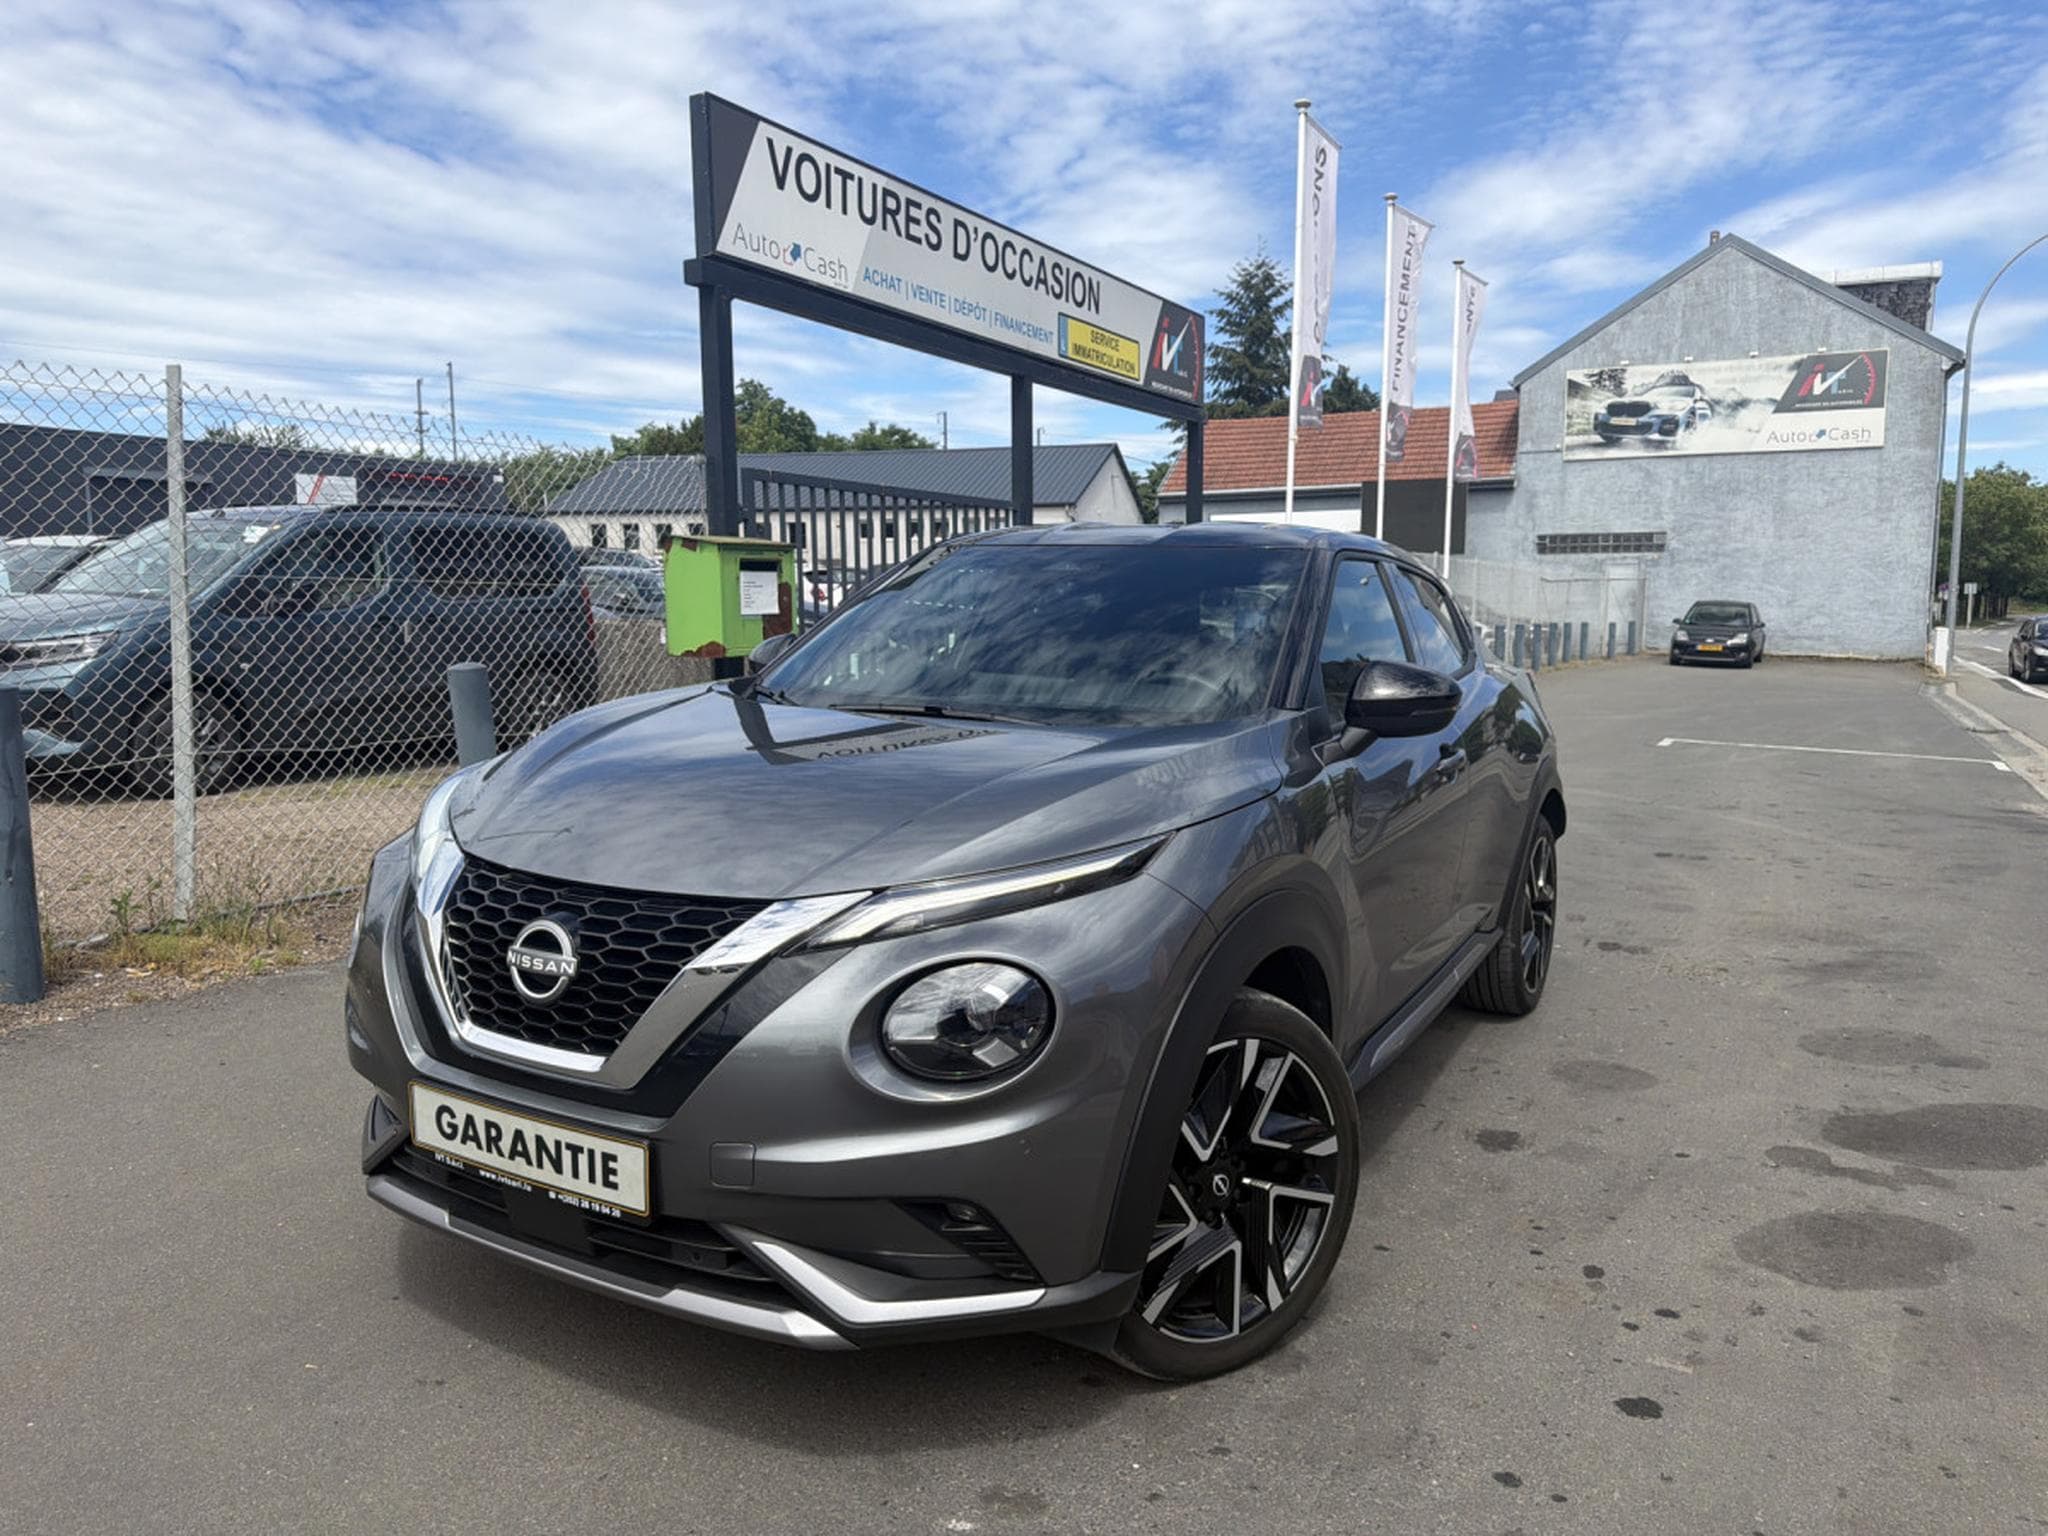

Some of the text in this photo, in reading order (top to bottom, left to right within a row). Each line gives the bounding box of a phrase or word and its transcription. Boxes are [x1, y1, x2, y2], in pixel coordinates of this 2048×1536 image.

[733, 222, 849, 282] Auto Cash
[765, 136, 1101, 315] VOITURES D'OCCASION
[863, 267, 1054, 343] ACHAT VENTE DÉPÔT FINANCEMENT
[1392, 229, 1417, 392] FINANCEMENT
[1072, 342, 1137, 375] IMMATRICULATION
[1090, 329, 1120, 352] SERVICE
[1767, 427, 1872, 444] Auto Cash
[507, 949, 575, 974] NISSAN
[434, 1104, 619, 1190] GARANTIE
